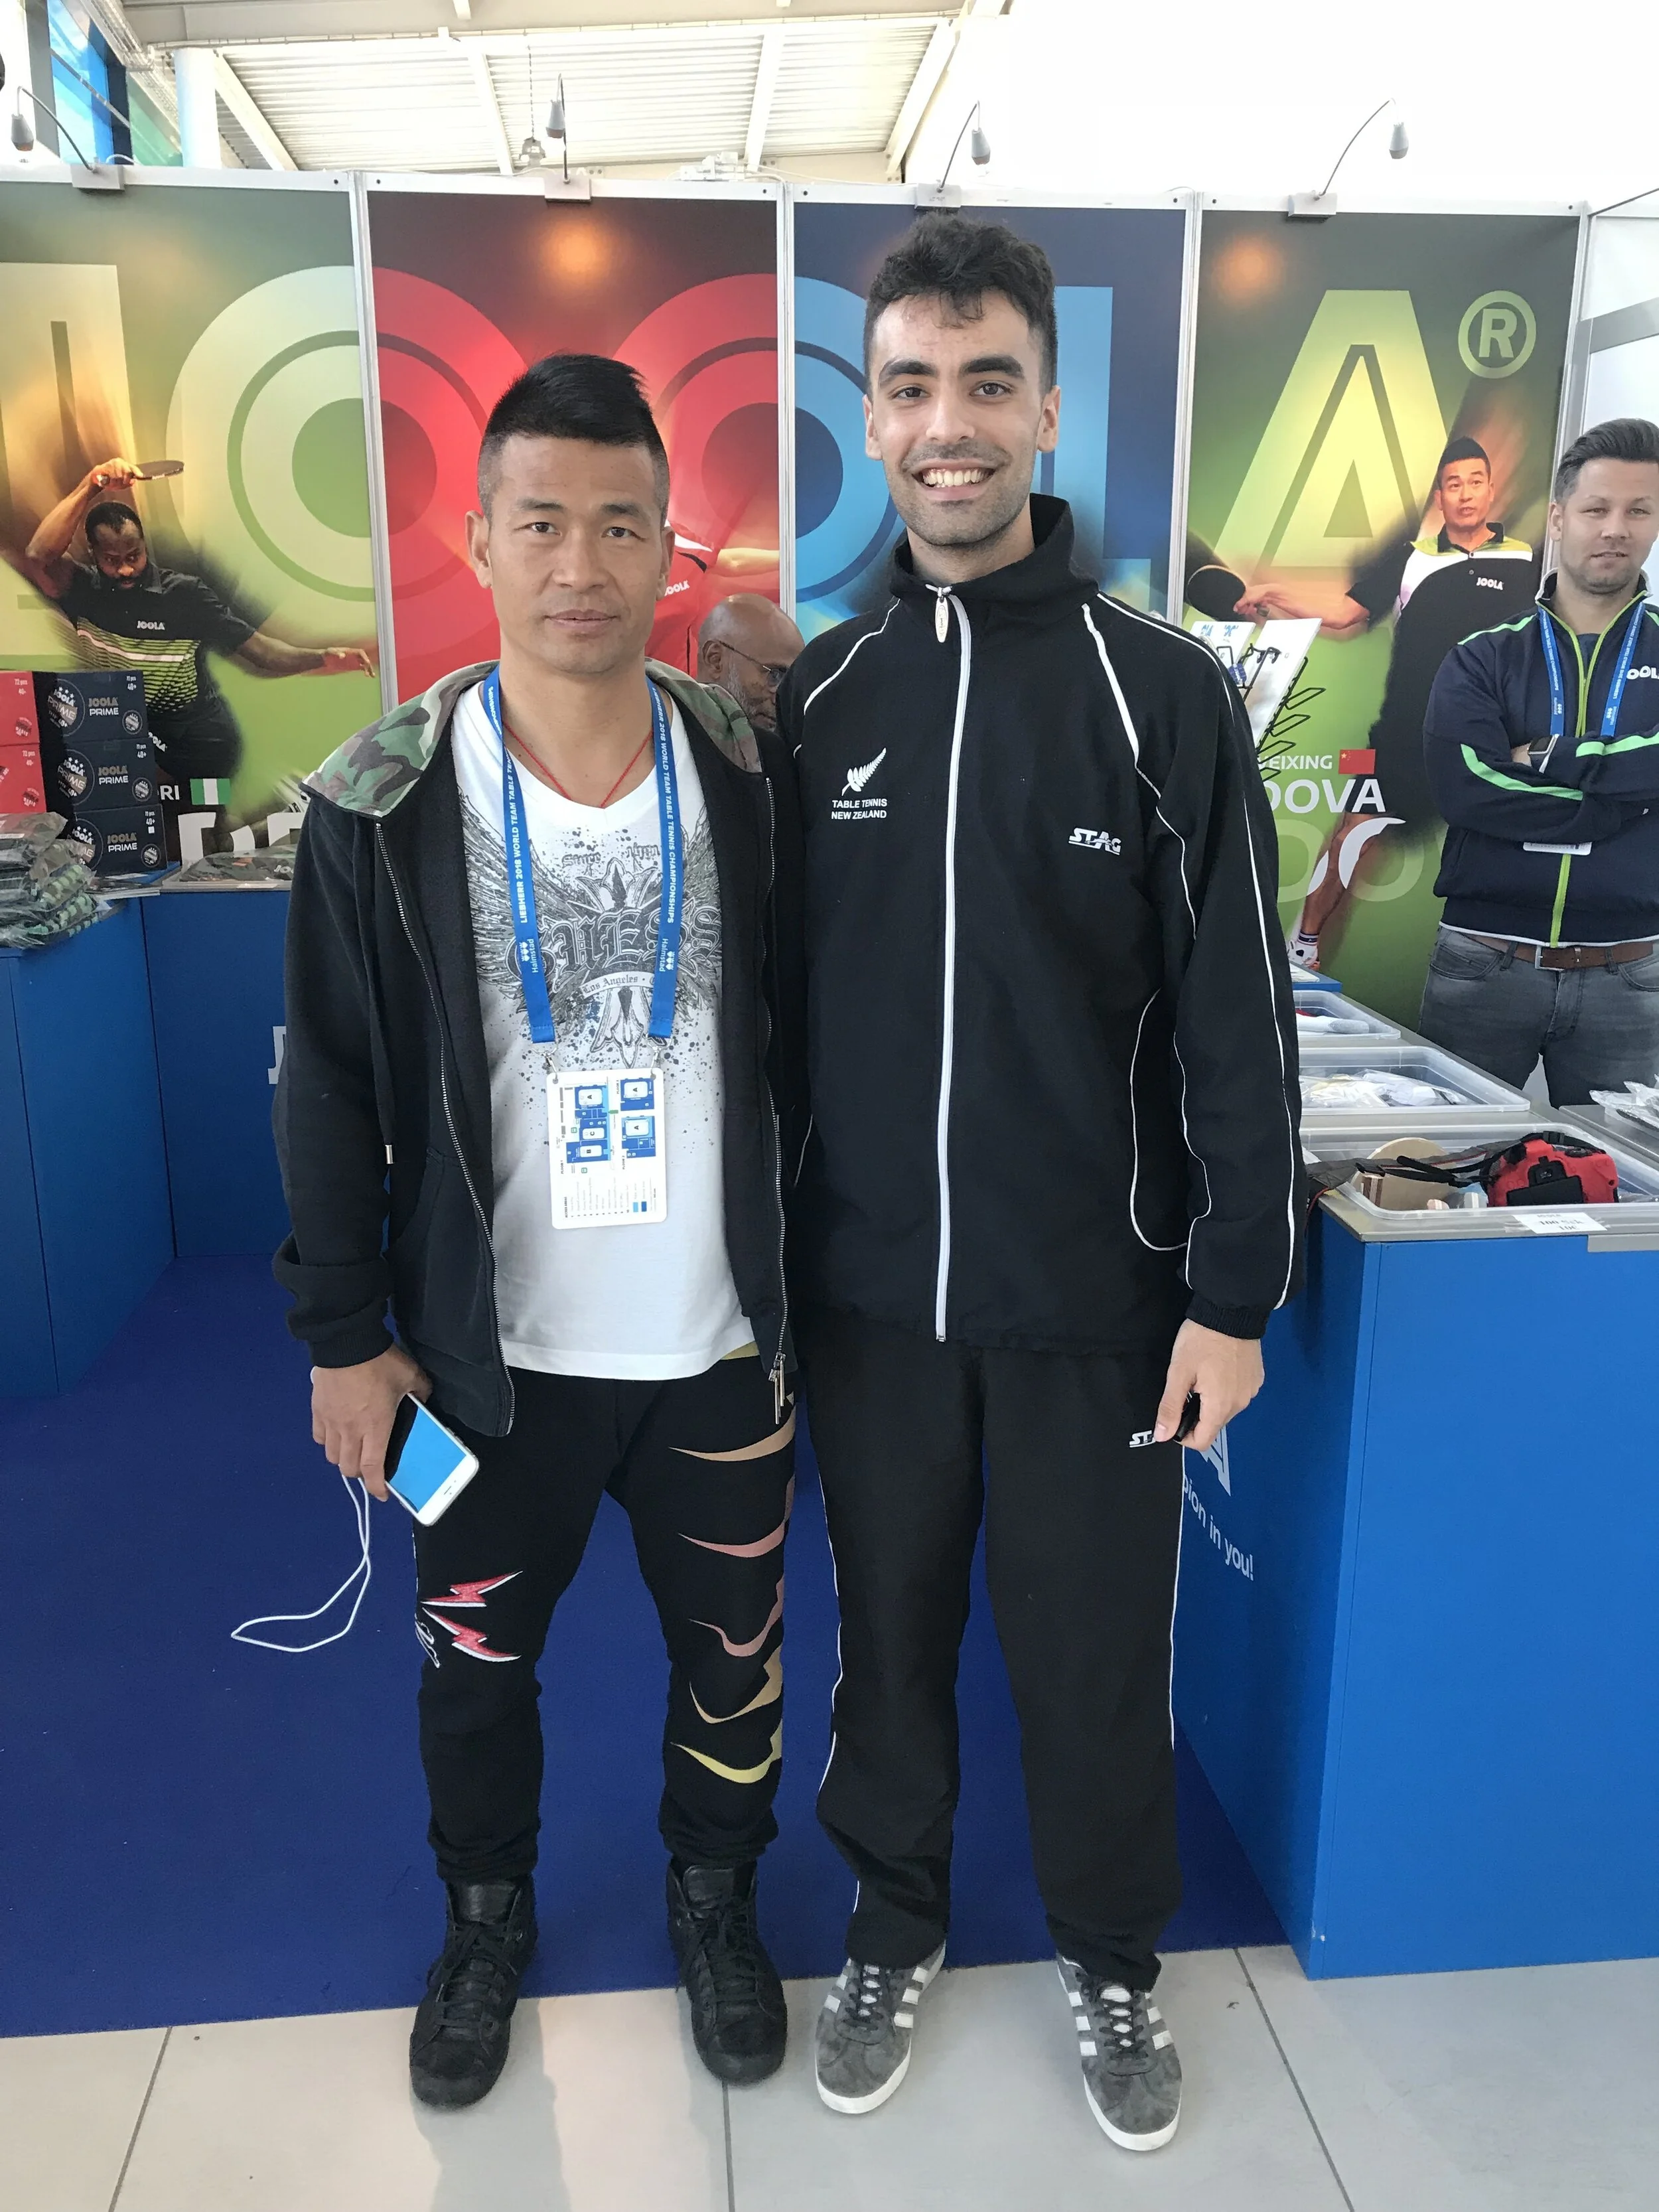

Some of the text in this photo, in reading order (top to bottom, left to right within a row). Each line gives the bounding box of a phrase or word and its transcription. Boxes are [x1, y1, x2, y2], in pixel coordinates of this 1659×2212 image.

[664, 579, 690, 597] OOLA
[1476, 577, 1503, 590] JOOLA
[137, 621, 165, 630] JOOLA
[1626, 666, 1659, 680] OOL
[54, 689, 76, 707] JOOLA
[88, 697, 118, 707] JOOLA
[89, 707, 119, 716] PRIME
[63, 759, 85, 776] JOOLA
[98, 765, 128, 776] JOOLA
[99, 776, 129, 785] PRIME
[157, 784, 180, 800] RI
[652, 687, 664, 723] LIEBHERR
[660, 743, 669, 771] WORLD
[667, 851, 676, 923] CHAMPIONSHIPS
[831, 798, 888, 808] TABLE TENNIS
[509, 802, 518, 825] TEAM
[831, 810, 887, 820] NEW ZEALAND
[108, 833, 137, 844] JOOLA
[512, 826, 521, 857] WORLD
[1068, 828, 1121, 855] STAG
[108, 843, 137, 853] PRIME
[514, 859, 523, 879] 2018
[516, 881, 528, 924] LIEBHERR
[528, 938, 538, 973] Halmstad
[659, 938, 668, 972] Halmstad
[582, 982, 601, 994] Los
[603, 974, 638, 988] Angeles
[1129, 1430, 1155, 1447] ST
[1210, 1514, 1221, 1550] in
[1224, 1537, 1254, 1581] you!
